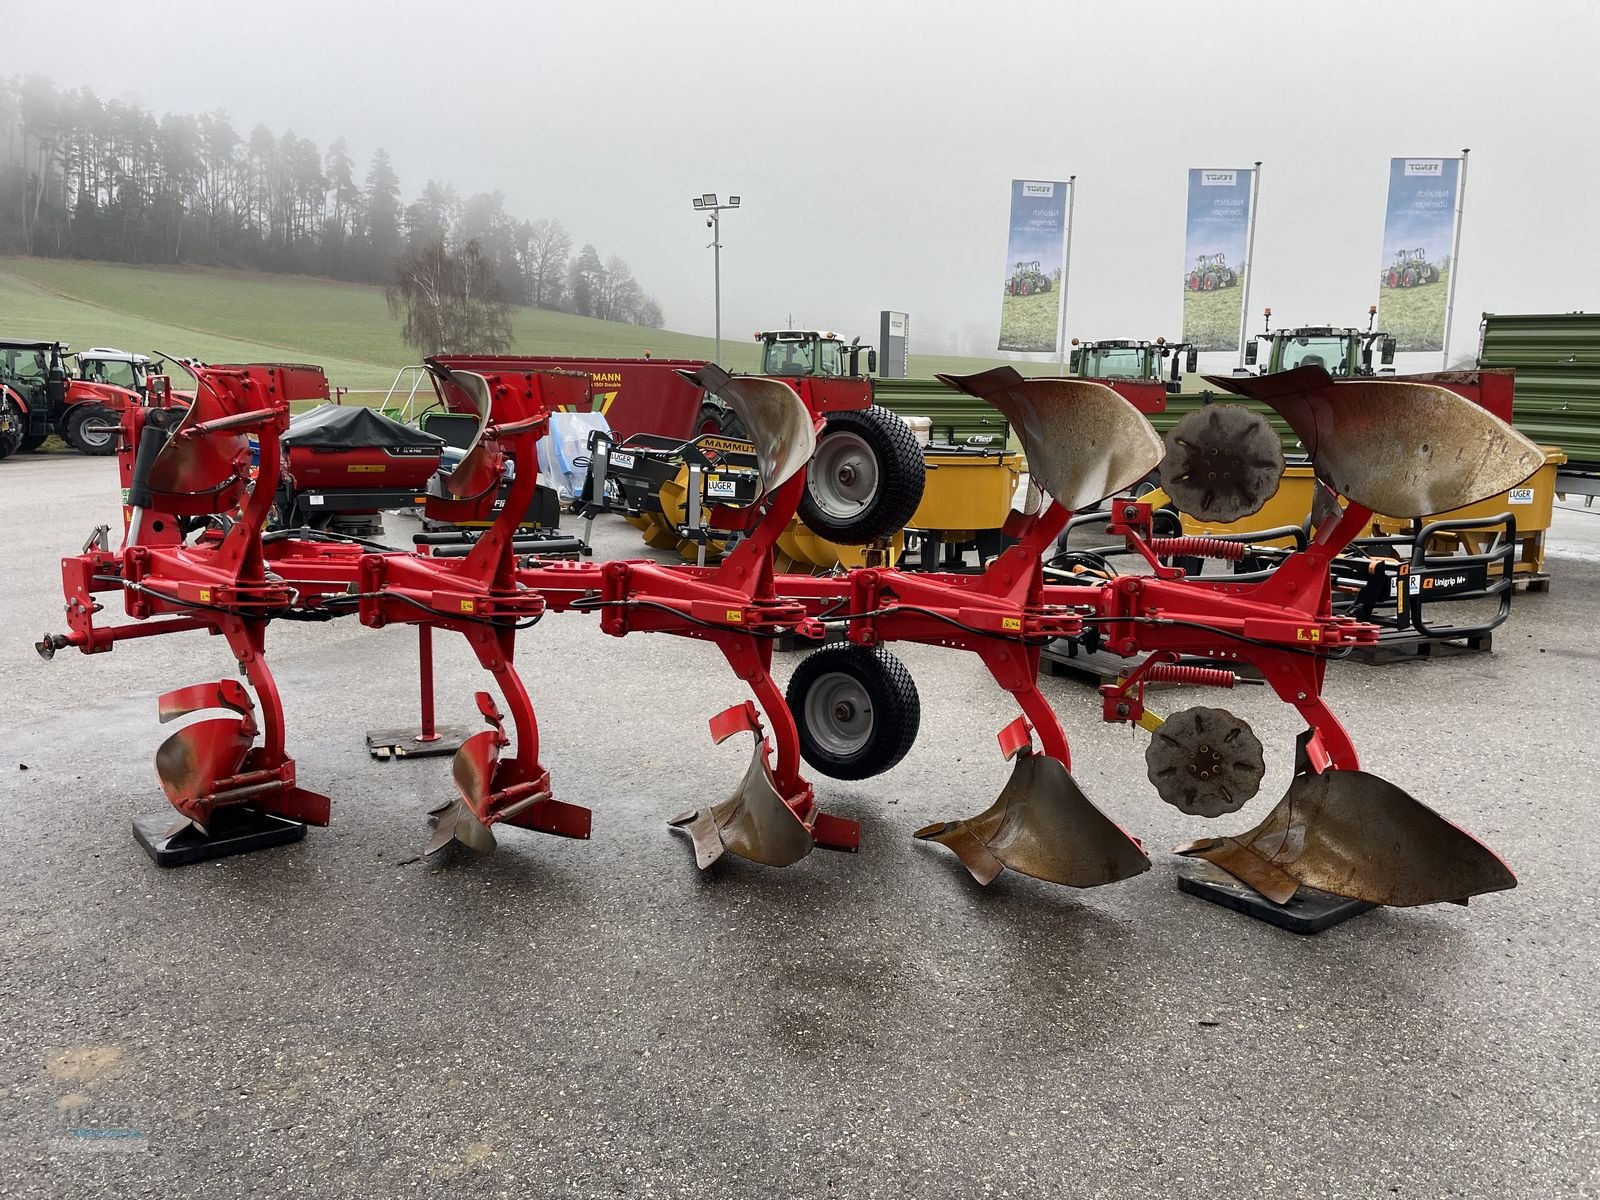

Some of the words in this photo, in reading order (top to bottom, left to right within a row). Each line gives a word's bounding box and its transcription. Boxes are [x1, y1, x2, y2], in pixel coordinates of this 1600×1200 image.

[704, 439, 756, 453] MAMMUT
[610, 452, 632, 463] LUGER
[708, 481, 732, 490] LUGER
[1509, 490, 1531, 498] LUGER
[1434, 577, 1456, 588] Unigrip
[1456, 576, 1466, 585] M+
